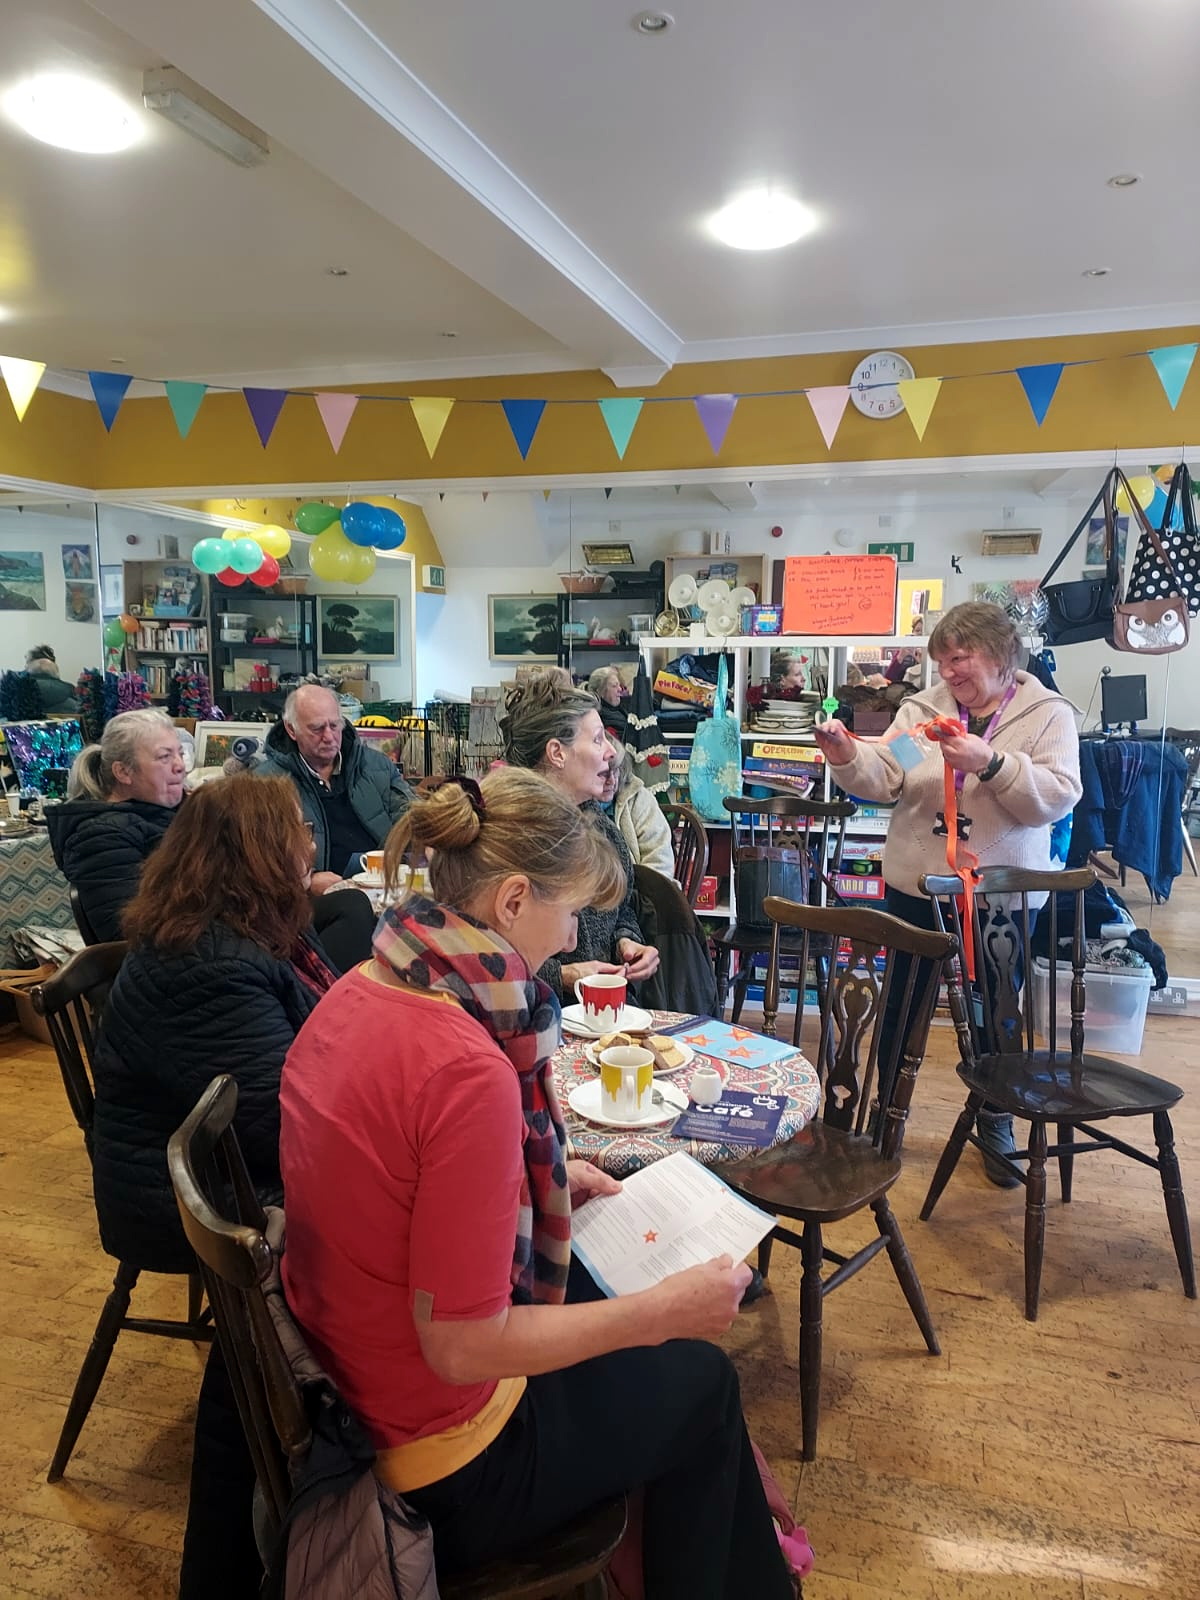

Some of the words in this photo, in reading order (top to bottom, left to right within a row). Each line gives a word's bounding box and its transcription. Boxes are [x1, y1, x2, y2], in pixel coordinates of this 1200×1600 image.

[869, 363, 877, 372] 11
[861, 370, 871, 379] 10
[695, 1103, 754, 1118] Café
